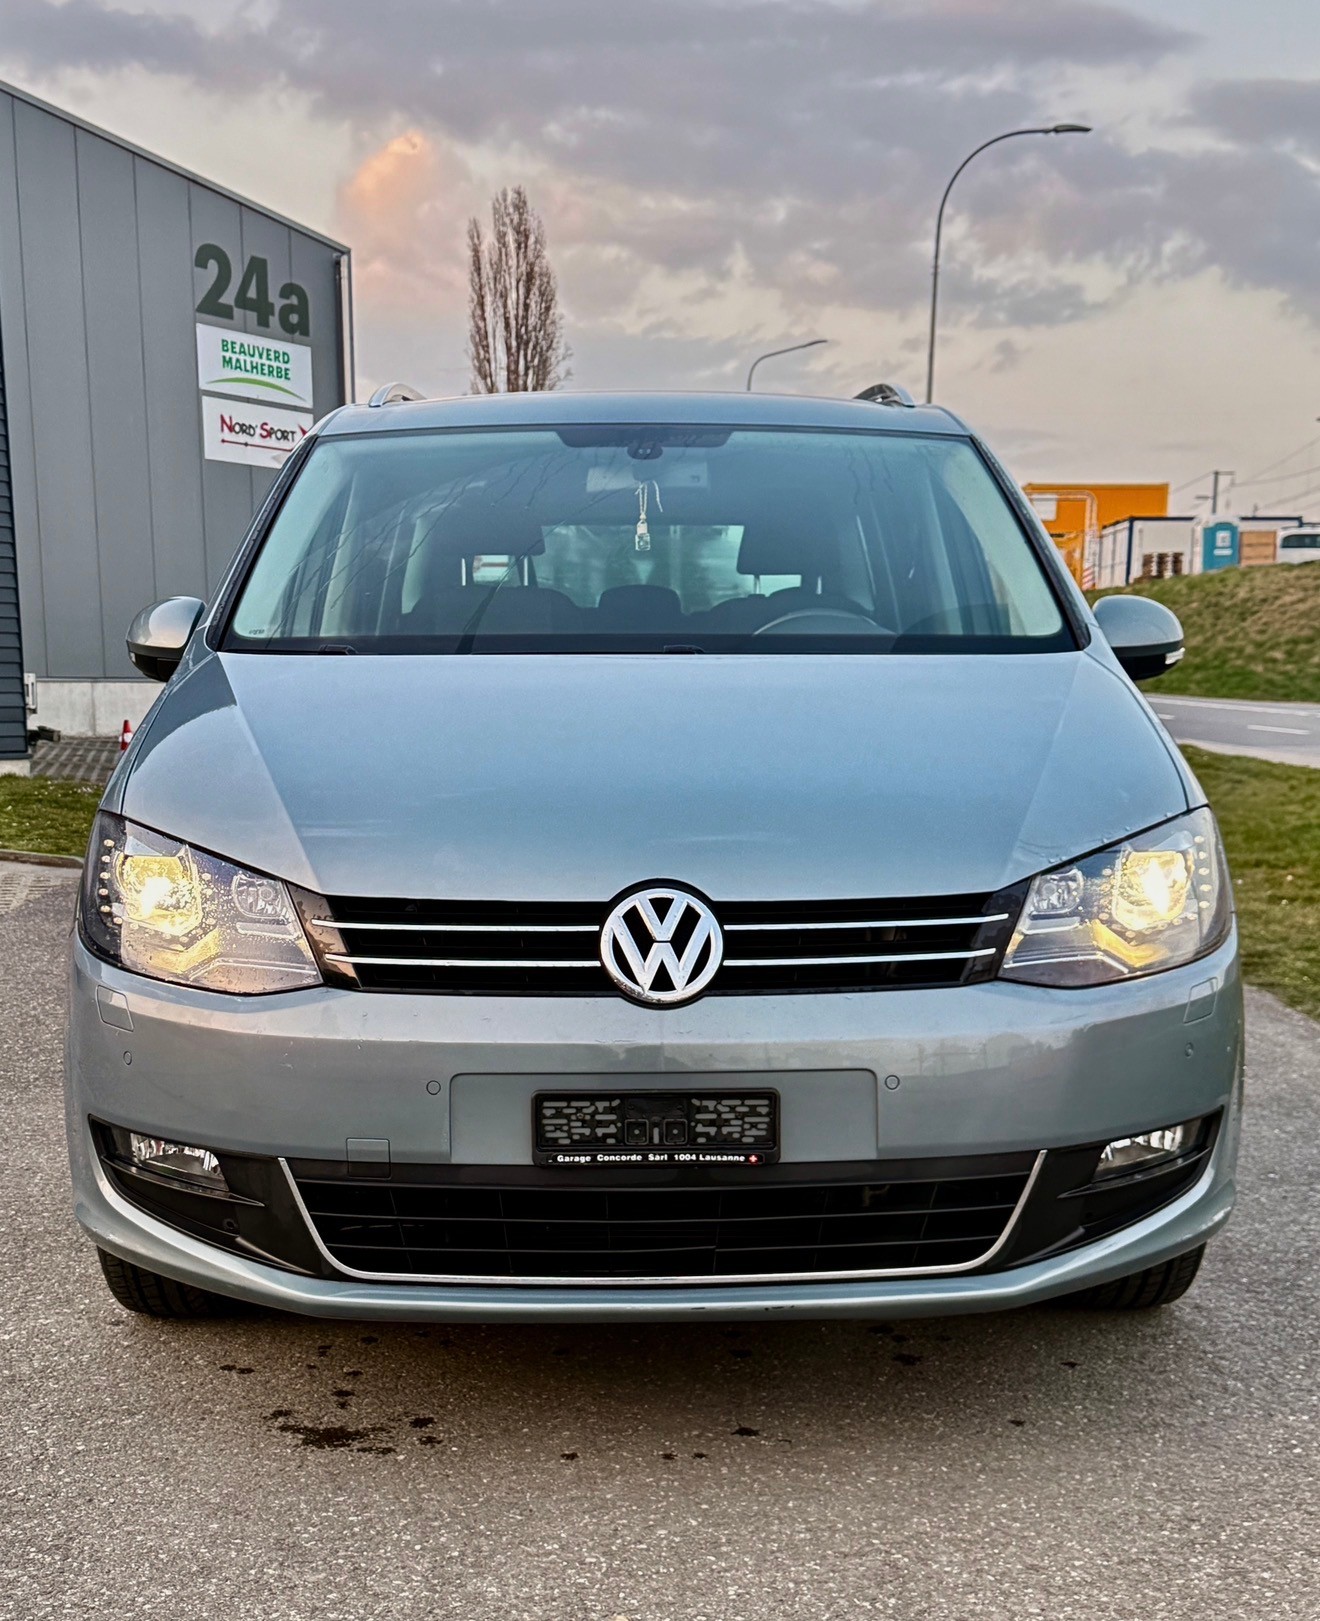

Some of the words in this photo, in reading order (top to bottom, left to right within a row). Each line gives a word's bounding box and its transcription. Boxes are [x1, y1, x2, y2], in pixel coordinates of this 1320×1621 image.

[195, 243, 310, 337] 24a
[221, 339, 290, 364] BEAUVERD
[222, 355, 291, 380] MALHERBE
[601, 888, 723, 1004] VW
[557, 1154, 592, 1164] Garage
[596, 1153, 643, 1162] Concorde
[674, 1153, 697, 1161] 1004
[698, 1153, 746, 1162] Lausanne
